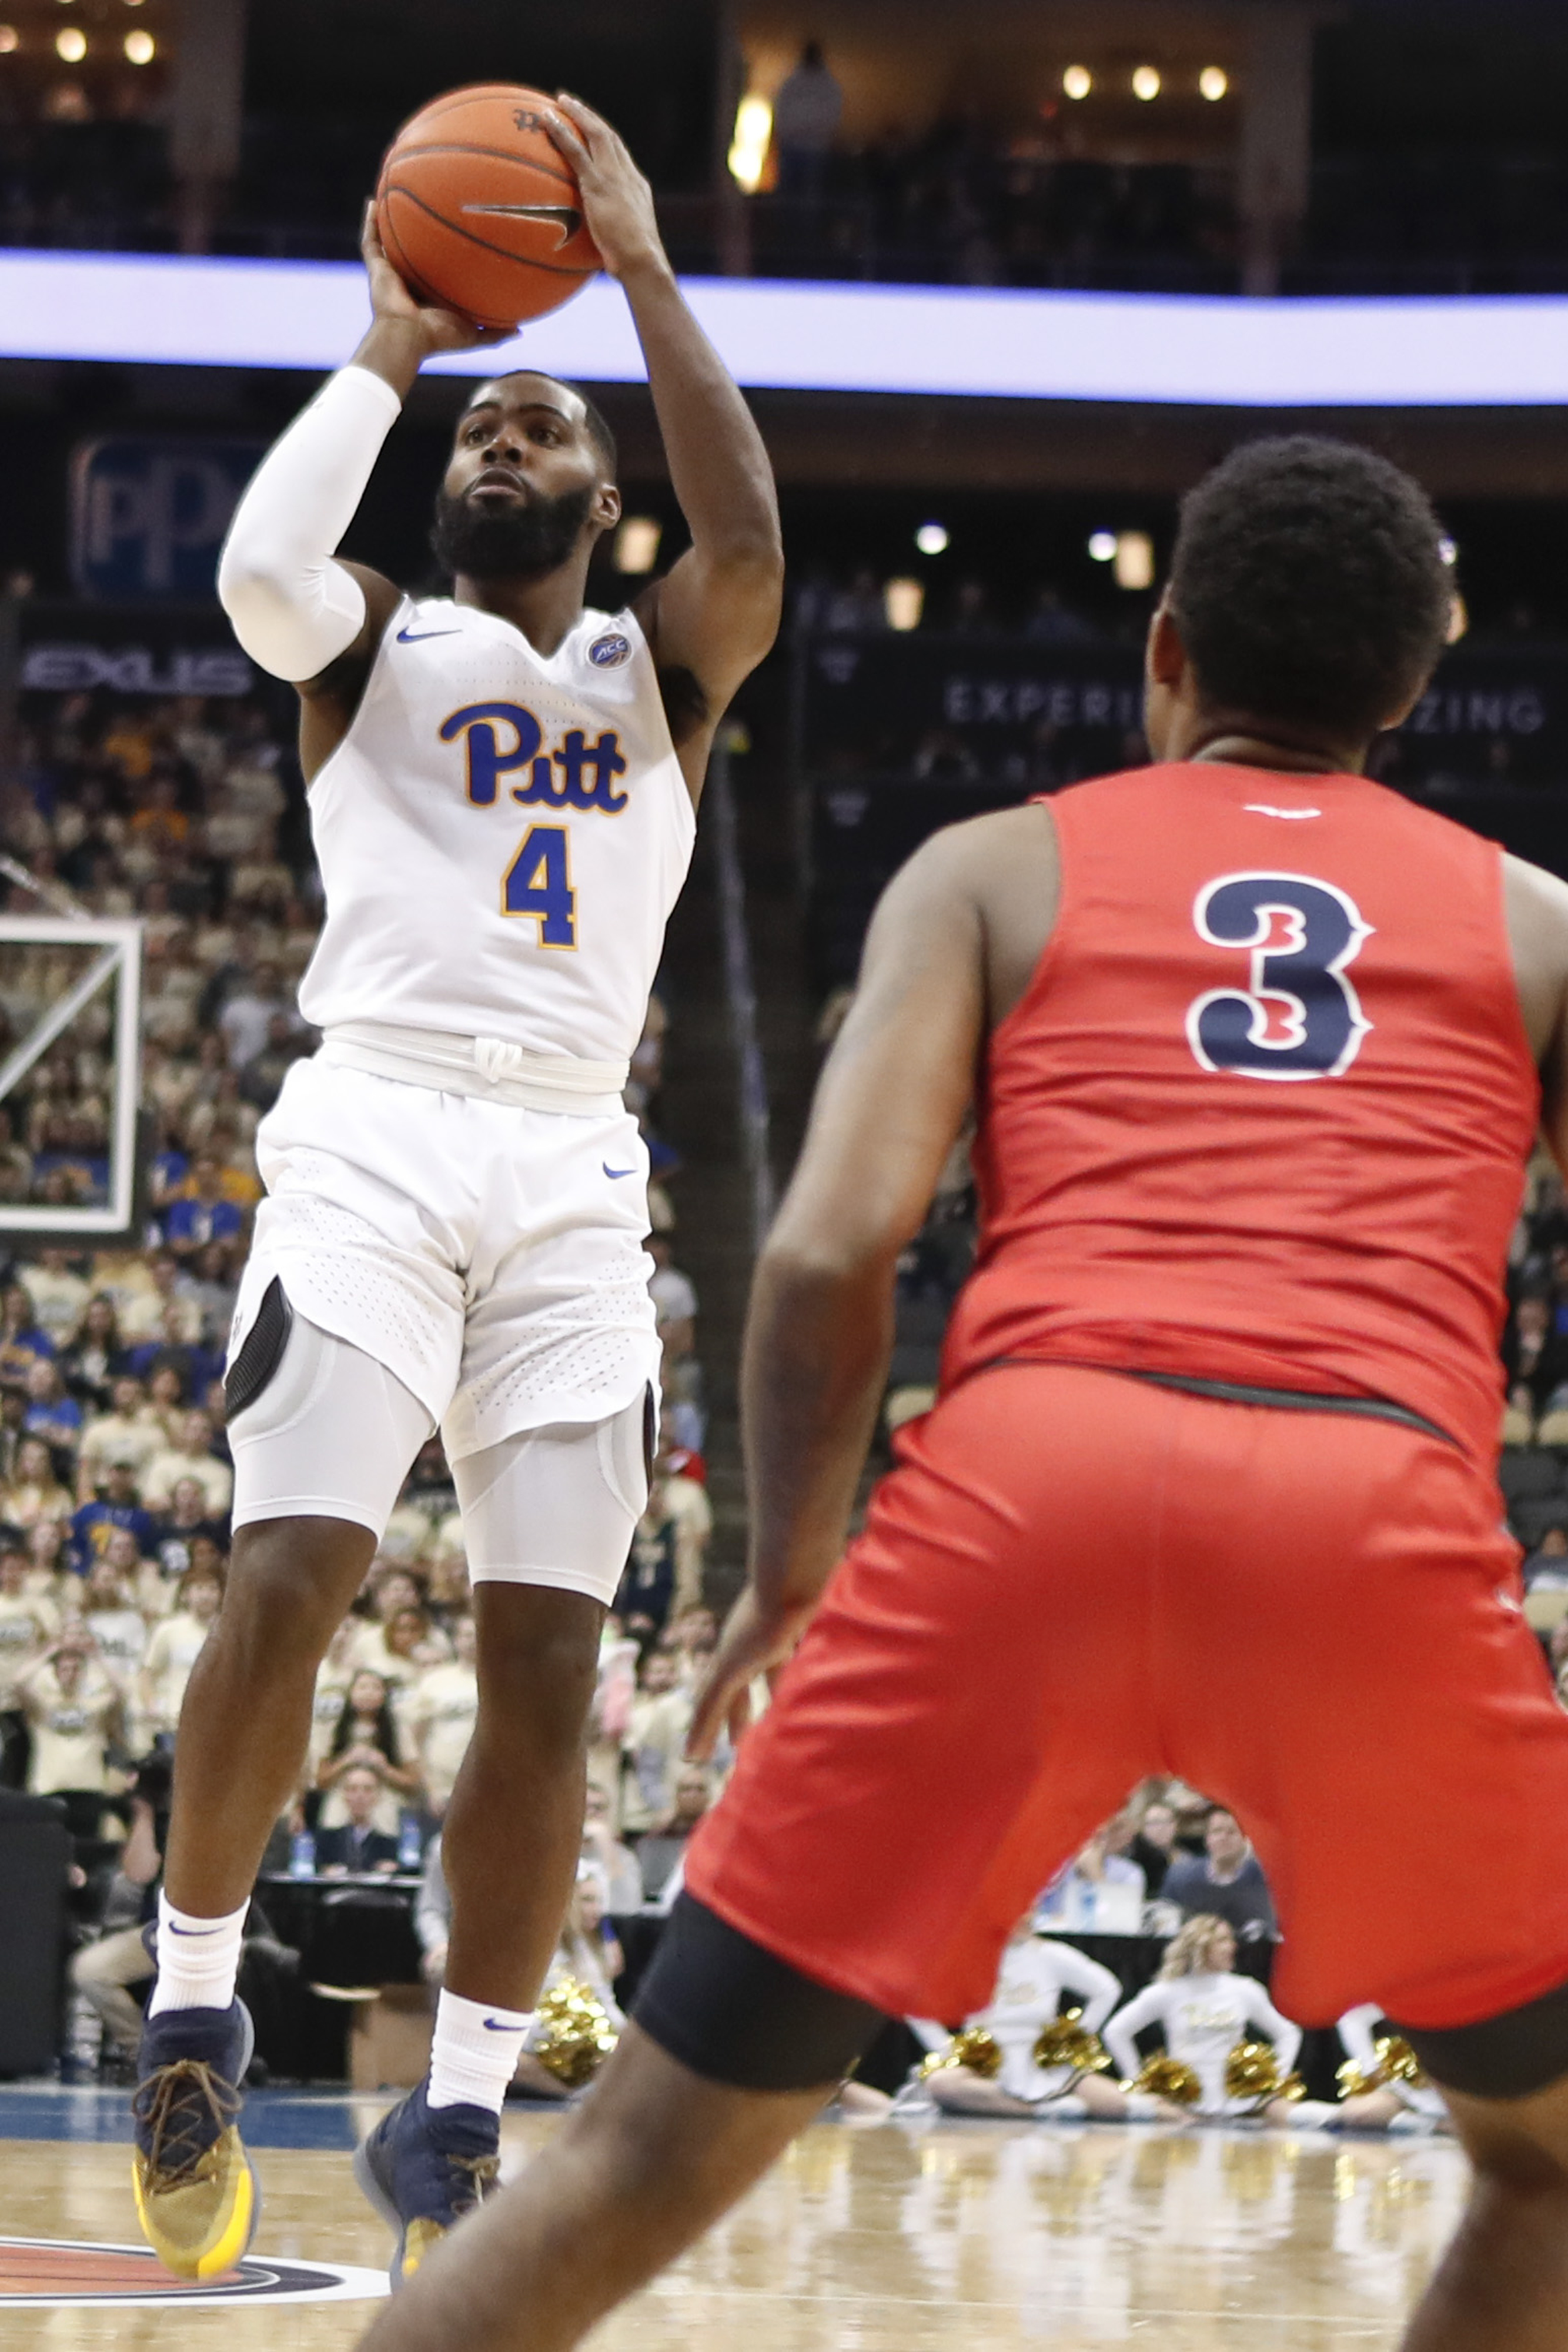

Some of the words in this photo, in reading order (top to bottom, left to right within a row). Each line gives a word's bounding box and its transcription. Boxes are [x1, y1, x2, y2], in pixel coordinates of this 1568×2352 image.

[88, 456, 236, 588] PP
[24, 649, 253, 695] EXUS
[596, 639, 626, 663] ACC
[947, 679, 1135, 724] EXPERI
[1414, 687, 1544, 733] ZING
[439, 700, 629, 817] Pitt
[500, 823, 578, 951] 4
[1185, 871, 1377, 1081] 3
